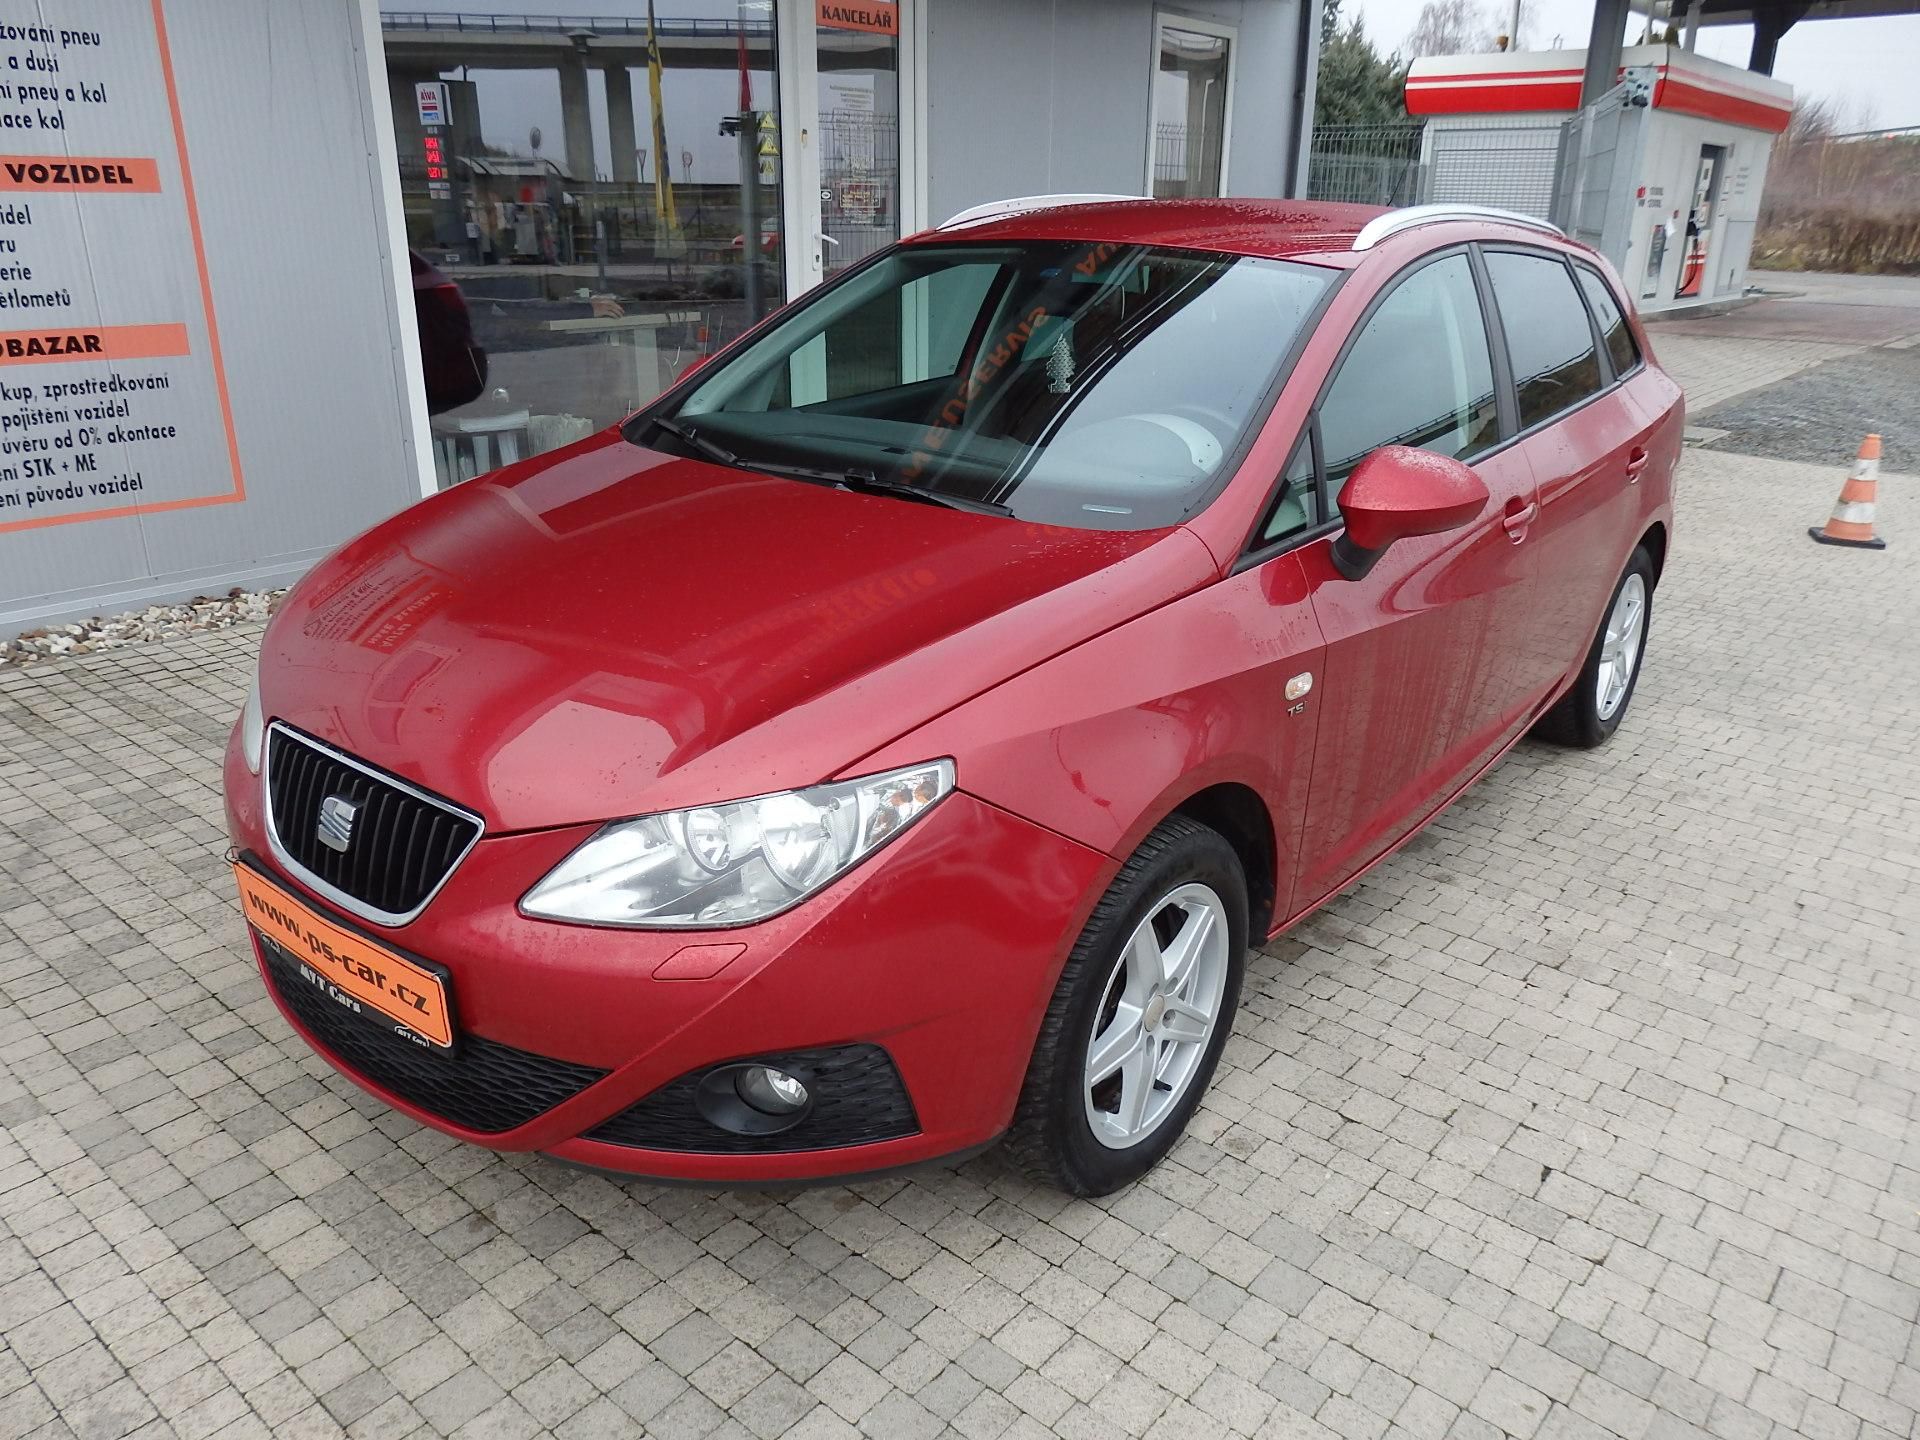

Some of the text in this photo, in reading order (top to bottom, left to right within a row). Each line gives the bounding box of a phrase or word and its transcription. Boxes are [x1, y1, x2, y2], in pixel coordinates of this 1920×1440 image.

[822, 5, 891, 28] KANCELÁŘ
[60, 30, 100, 49] pneu
[8, 49, 59, 72] a duší
[18, 86, 58, 104] pneu
[66, 88, 75, 101] a
[80, 81, 107, 103] kol
[0, 108, 65, 130] ace kol
[5, 163, 133, 184] VOZIDEL
[0, 335, 102, 358] BAZAR
[43, 372, 169, 401] zprostředkování
[2, 399, 130, 432] pojištění vozidel
[3, 425, 176, 454] úvěru od 0% akontace
[23, 458, 56, 478] STK
[76, 453, 97, 472] ME
[26, 481, 83, 508] původu
[89, 473, 143, 496] vozidel
[247, 889, 430, 1016] www.ps-car.cz
